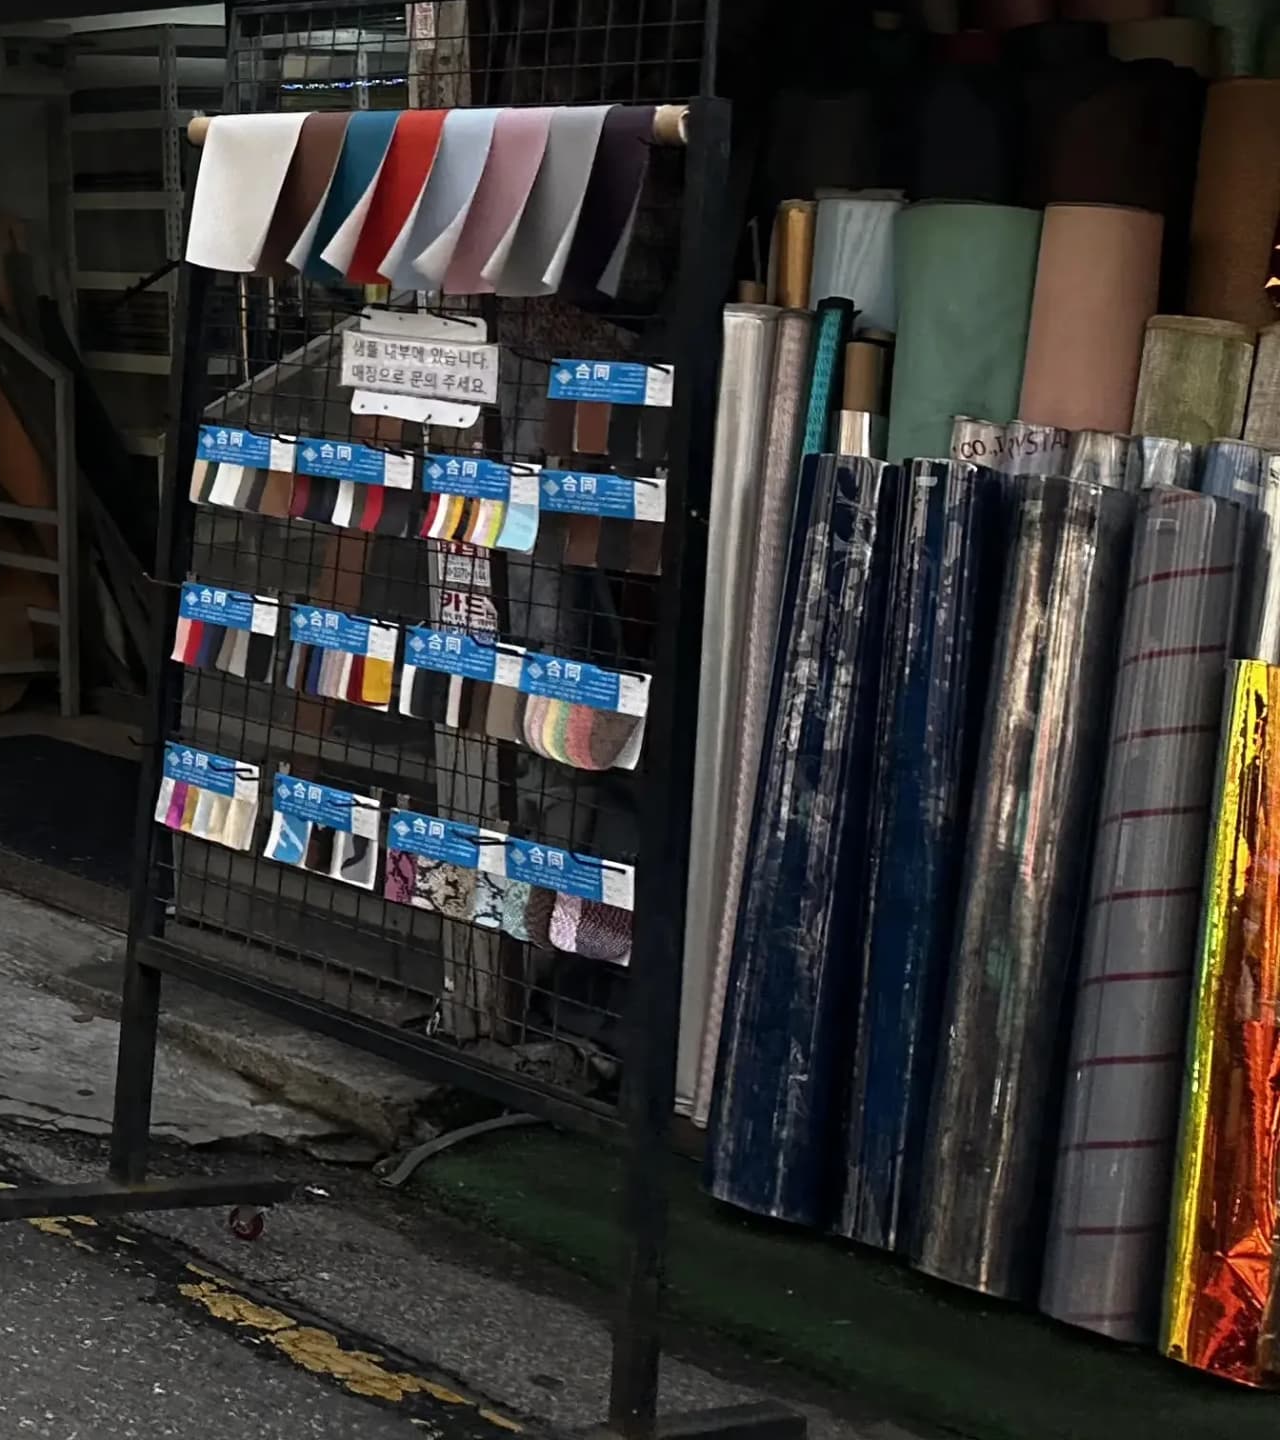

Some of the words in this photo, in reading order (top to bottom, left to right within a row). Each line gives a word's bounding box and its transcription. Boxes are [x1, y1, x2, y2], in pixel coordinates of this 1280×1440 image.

[384, 343, 425, 364] 내부에
[351, 364, 405, 385] 매장으로
[410, 370, 438, 390] 문의
[575, 363, 611, 381] 合同
[216, 430, 244, 448] 合同
[320, 443, 352, 462] 合同
[445, 459, 478, 478] 合同
[561, 474, 597, 495] 合同
[200, 588, 227, 607] 合同
[310, 611, 339, 630] 合同
[427, 633, 462, 655] 合同
[545, 660, 582, 682] 合同
[181, 749, 209, 770] 合同
[293, 782, 322, 804] 合同
[412, 818, 444, 840] 合同
[527, 846, 565, 871] 合同
